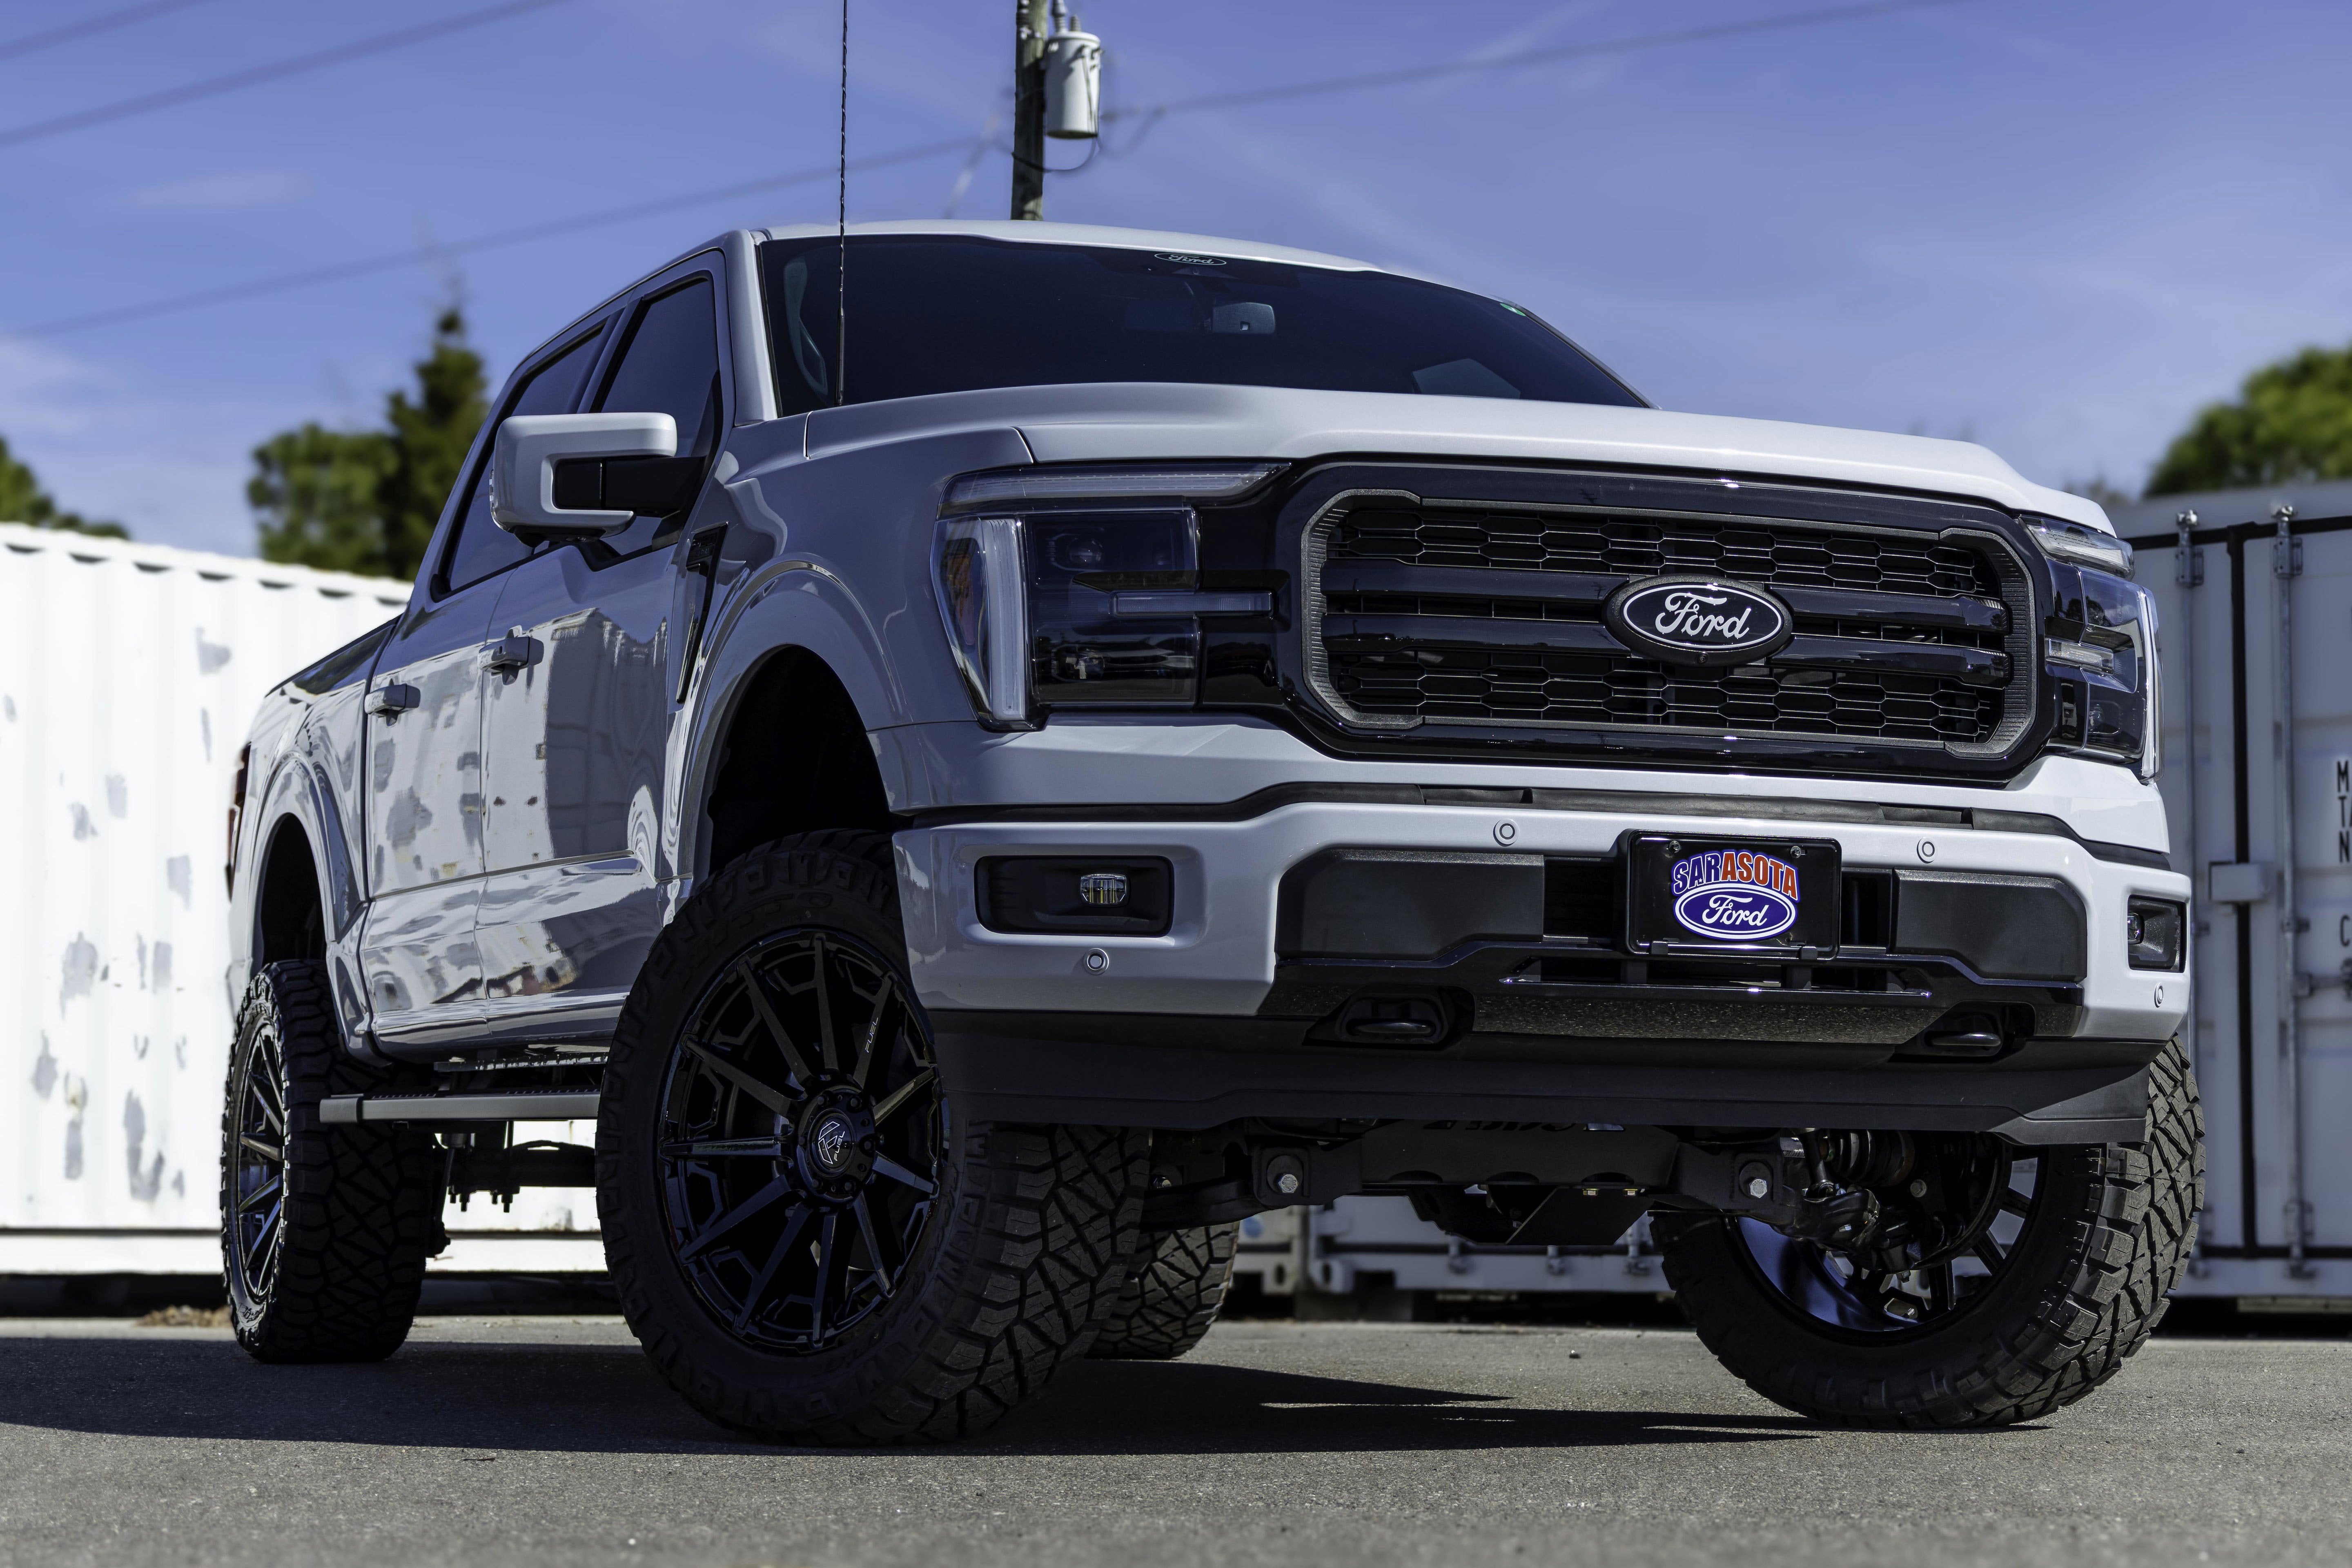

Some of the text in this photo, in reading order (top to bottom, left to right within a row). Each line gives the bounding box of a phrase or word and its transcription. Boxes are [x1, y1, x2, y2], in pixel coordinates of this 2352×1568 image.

[1168, 254, 1214, 264] Ford
[1655, 592, 1752, 639] Ford
[2337, 795, 2352, 828] T
[1673, 852, 1798, 901] SARASOTA
[1702, 895, 1769, 927] Ford
[865, 1017, 879, 1054] FUEL
[834, 1131, 845, 1161] FUEL
